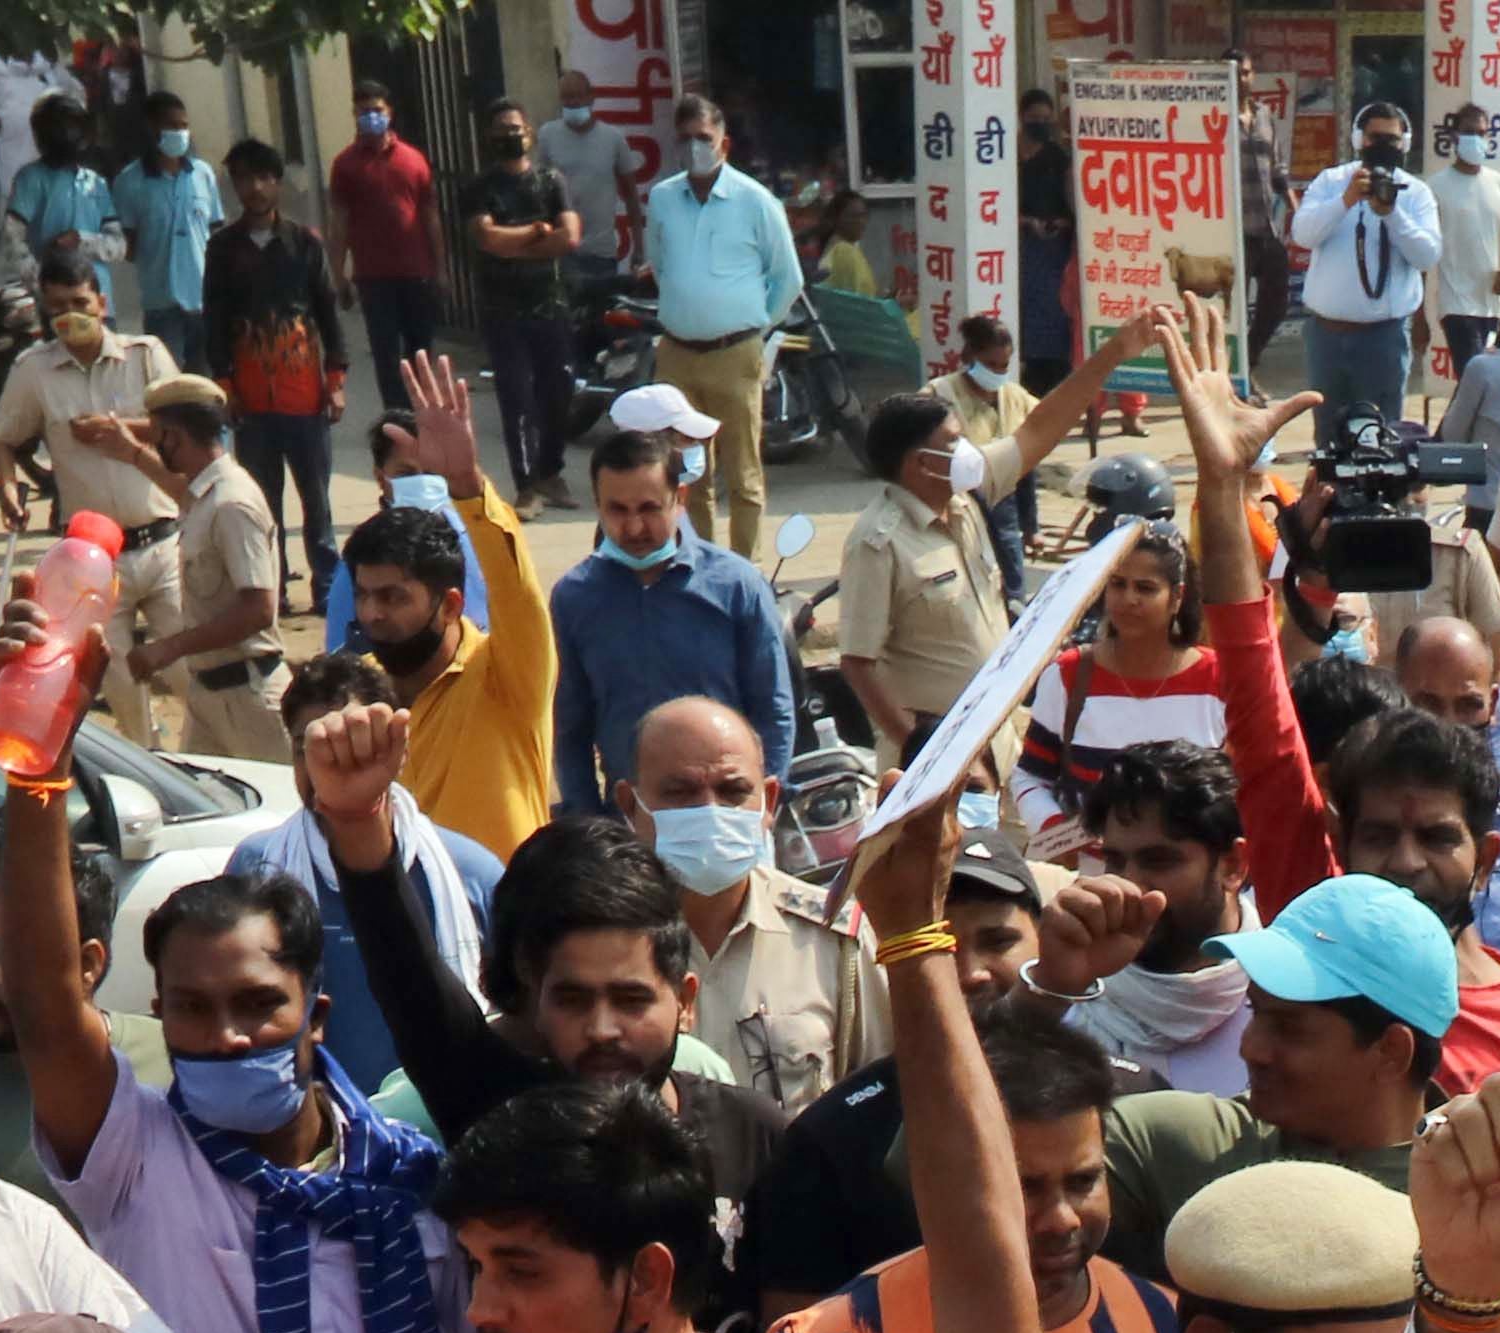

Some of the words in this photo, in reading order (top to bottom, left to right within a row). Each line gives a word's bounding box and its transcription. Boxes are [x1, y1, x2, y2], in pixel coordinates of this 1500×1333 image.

[1075, 83, 1125, 100] ENGLISH
[1130, 85, 1137, 101] &
[1141, 85, 1226, 102] HOMEOPATHIC
[1078, 117, 1161, 139] AYURVEDIC
[1077, 105, 1229, 232] दवाईयाँ
